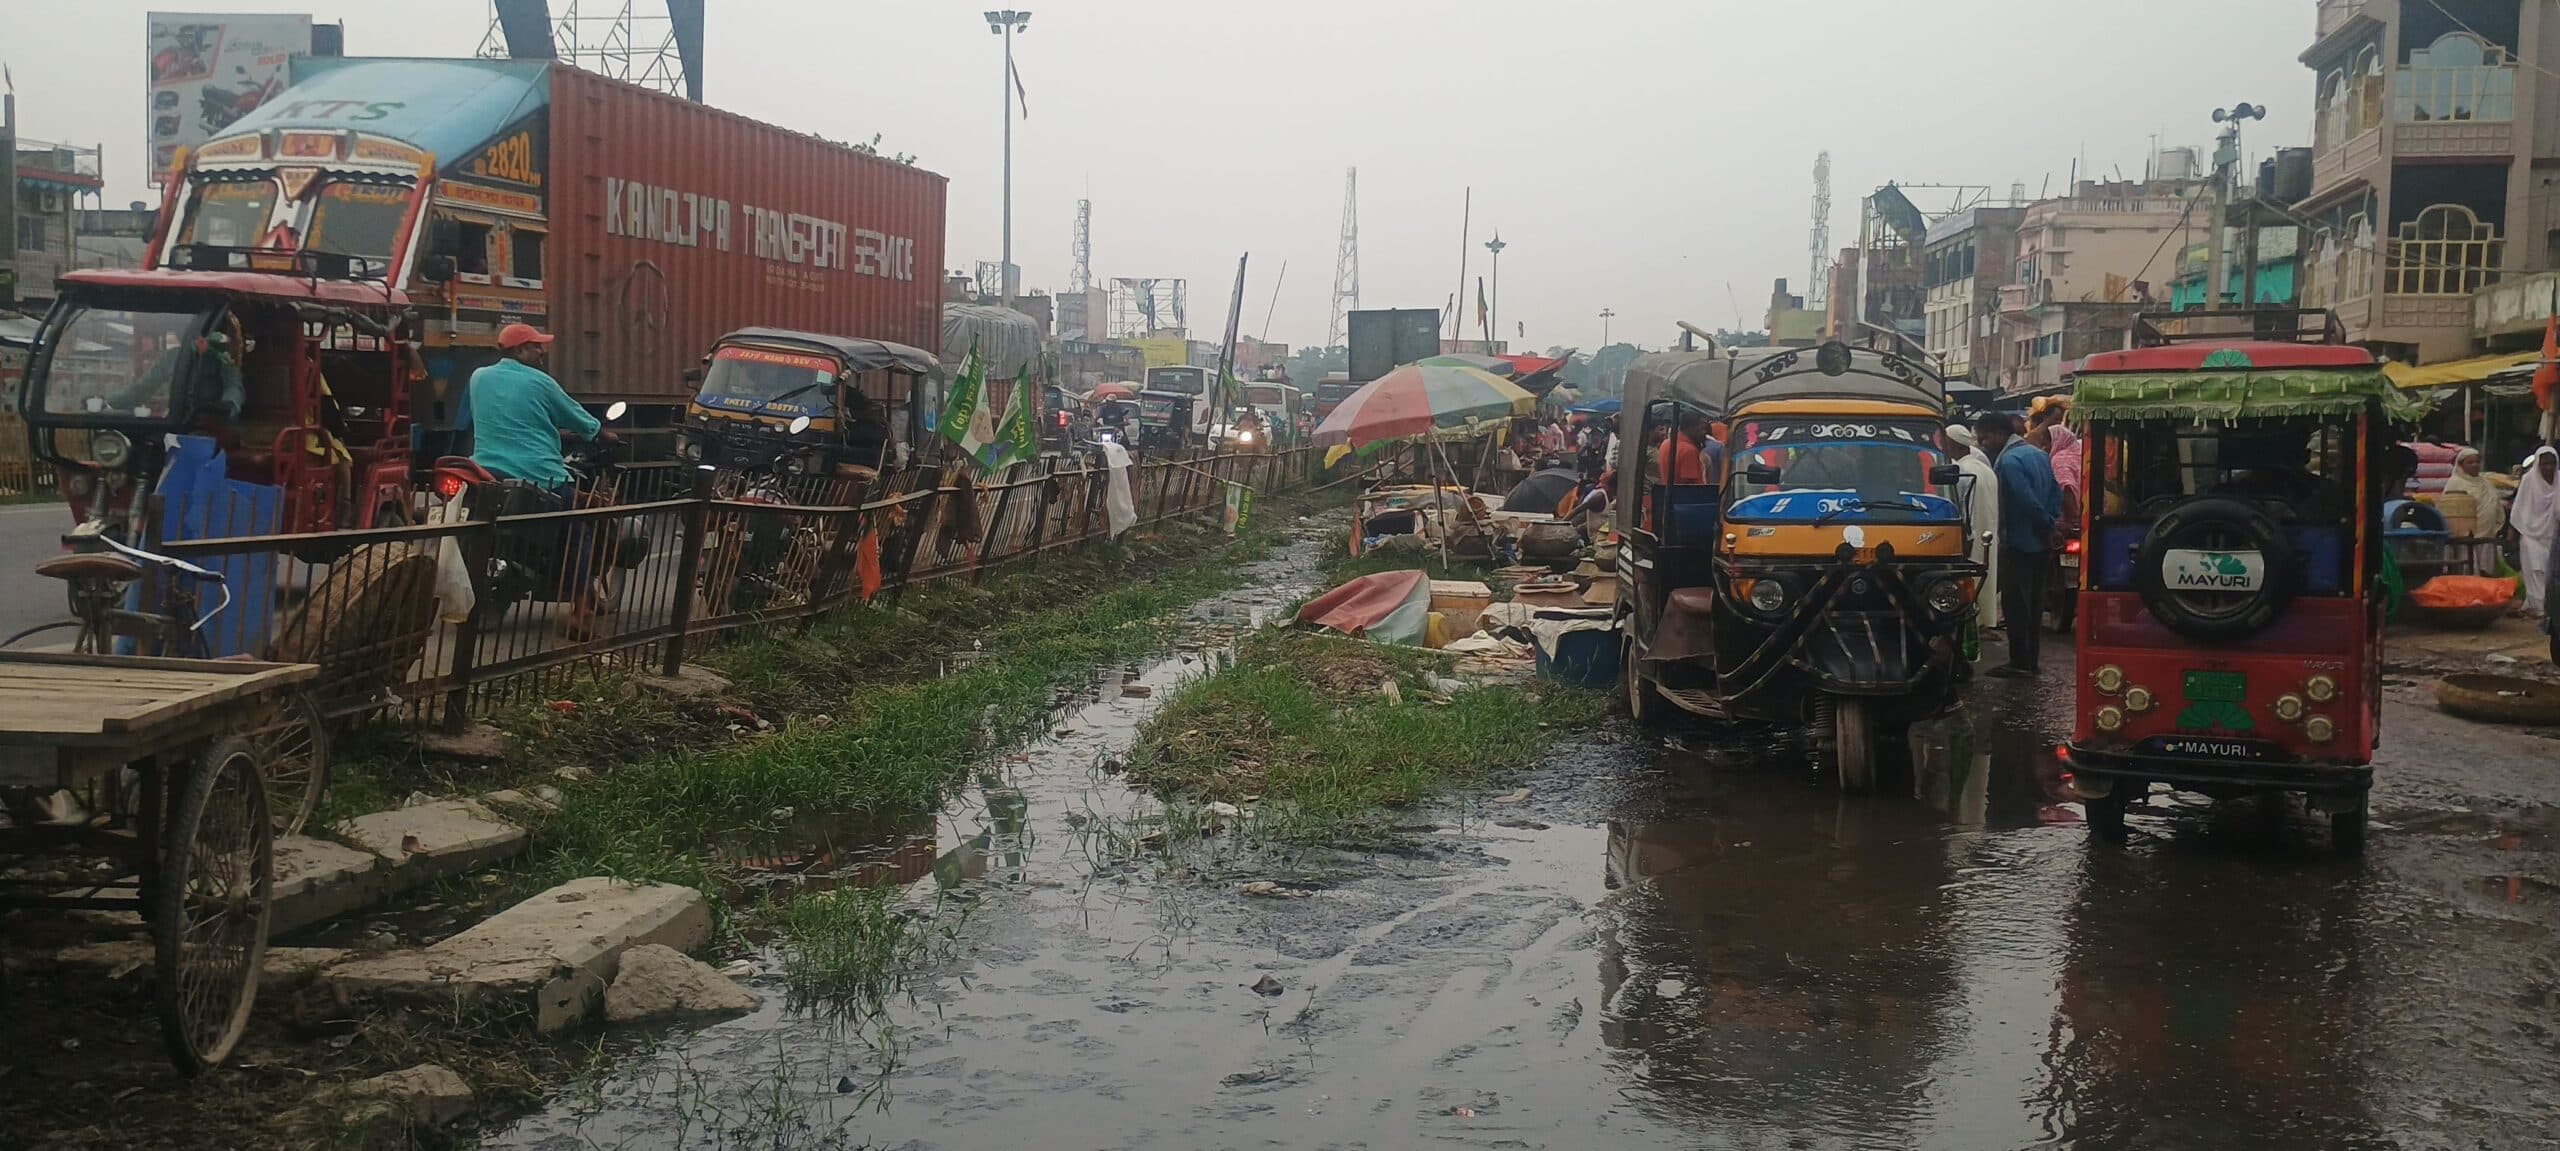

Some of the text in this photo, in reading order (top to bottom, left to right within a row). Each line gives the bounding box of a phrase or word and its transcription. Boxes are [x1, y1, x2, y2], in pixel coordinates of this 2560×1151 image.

[271, 100, 406, 120] KTS
[487, 131, 530, 181] 2820
[743, 204, 847, 270] TRANSPORT
[855, 228, 914, 281] SERVICE
[2178, 573, 2251, 588] MAYURI
[2185, 741, 2246, 756] MAYURI
